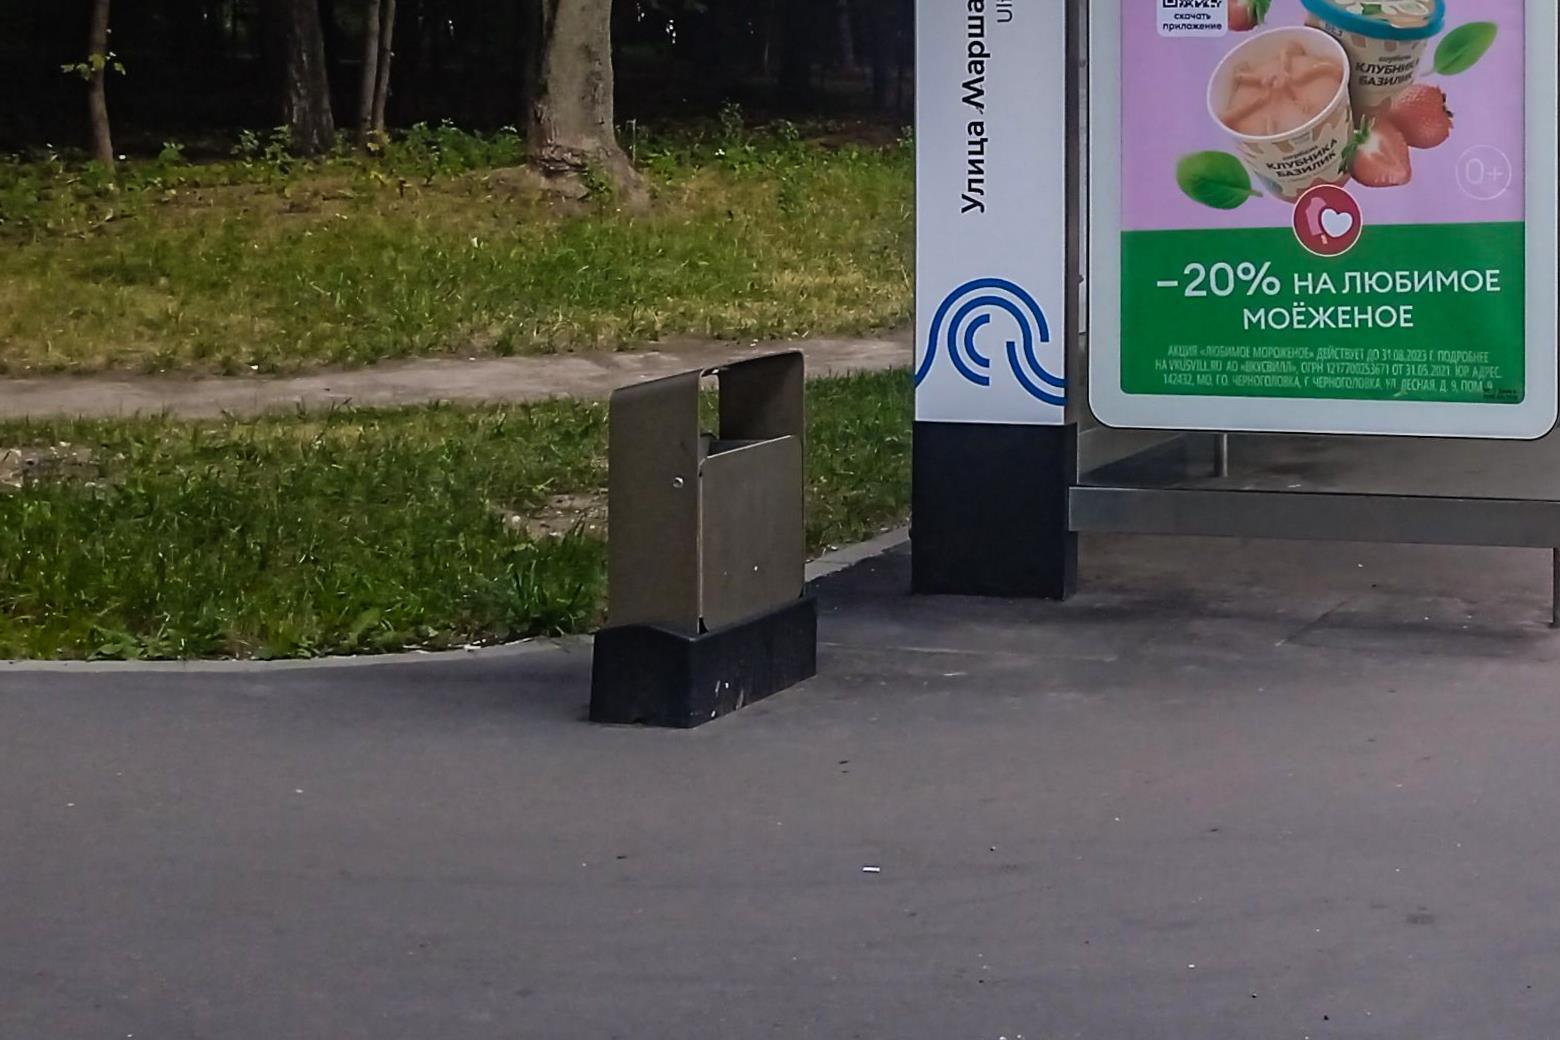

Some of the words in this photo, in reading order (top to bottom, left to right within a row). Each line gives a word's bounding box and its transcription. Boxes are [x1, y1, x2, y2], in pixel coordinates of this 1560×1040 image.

[1162, 23, 1222, 32] приложение
[1174, 13, 1211, 21] скачать
[1266, 138, 1338, 170] КЛУБНИКА
[1276, 150, 1336, 178] БАЗИЛИК
[961, 121, 988, 214] Улица
[1465, 158, 1503, 185] 0+
[1293, 272, 1337, 295] НА
[1342, 269, 1501, 294] ЛЮБИМОЕ
[1243, 302, 1414, 330] МОЁЖЕНОЕ
[1155, 360, 1167, 370] НА
[1301, 362, 1323, 373] ОГРН
[1392, 364, 1403, 375] ОТ
[1167, 345, 1198, 358] АКЦИЯ
[1316, 345, 1364, 360] ДЕЙСТВУЕТ
[1367, 348, 1379, 361] ДО
[1438, 350, 1489, 364] ПОДРОБНЕЕ
